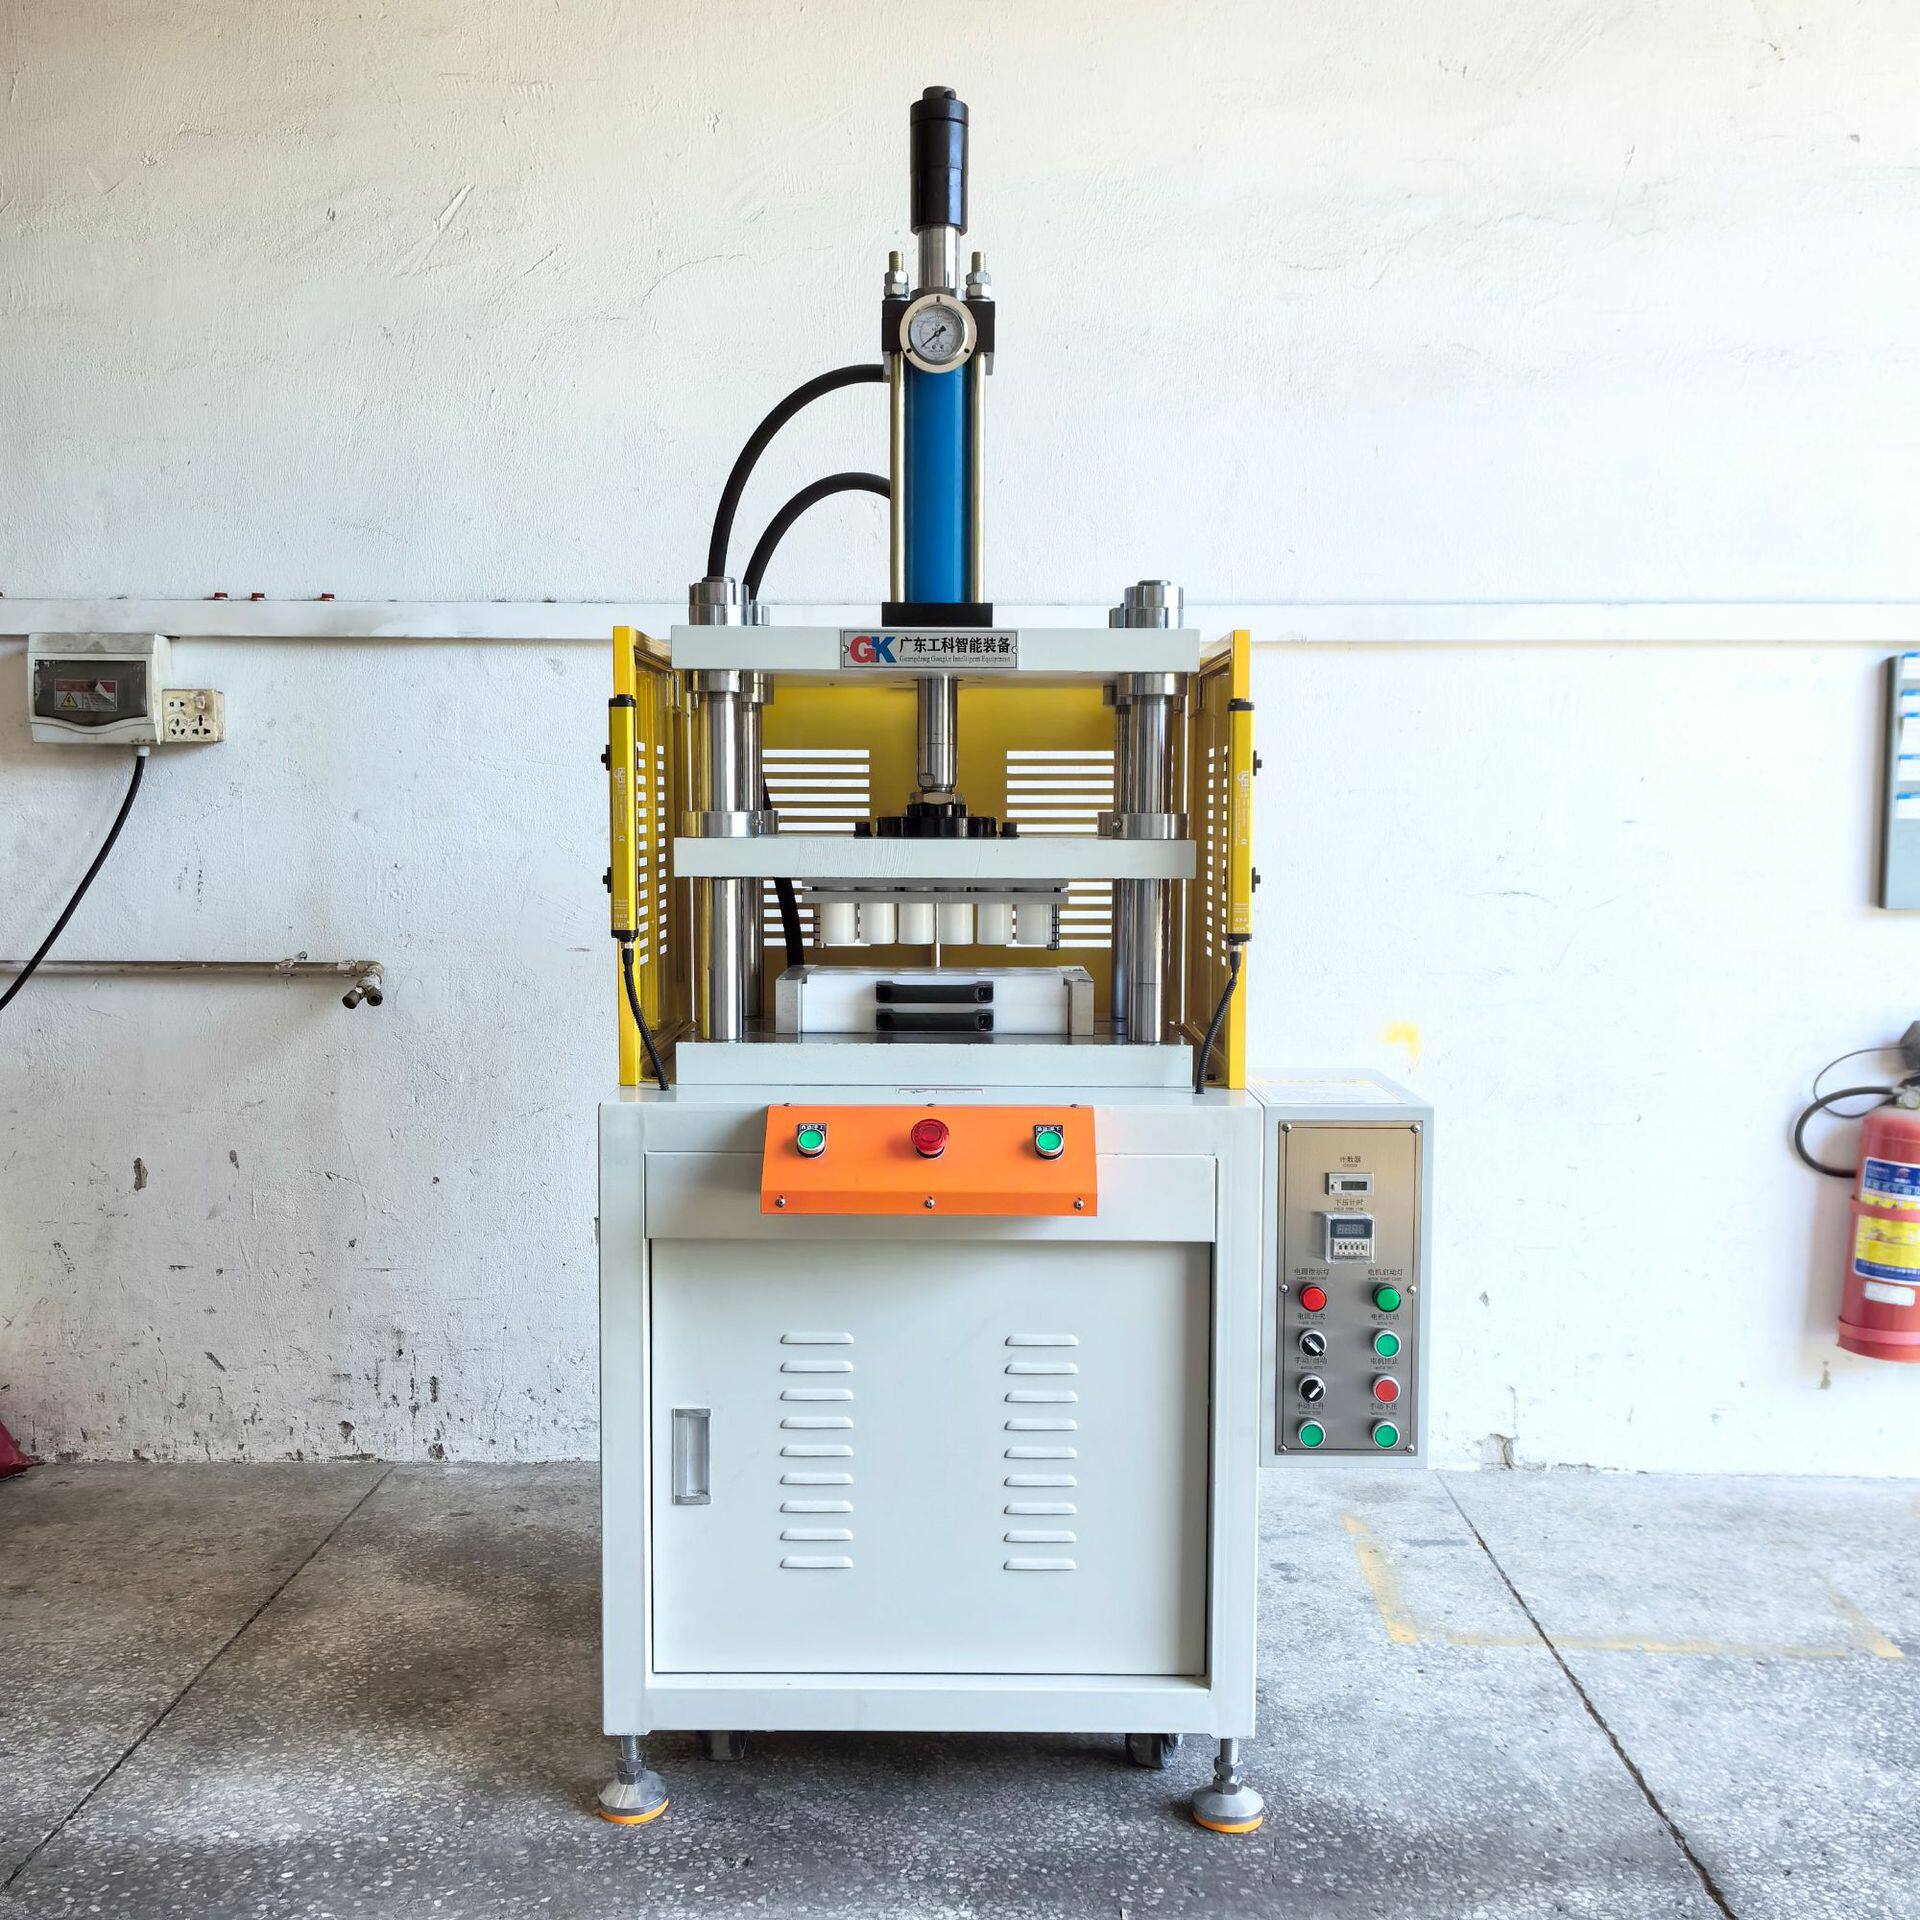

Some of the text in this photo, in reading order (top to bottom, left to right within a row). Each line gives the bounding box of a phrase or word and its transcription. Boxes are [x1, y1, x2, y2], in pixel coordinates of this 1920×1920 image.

[849, 635, 897, 664] GK
[899, 636, 1011, 654] 广东工科智能装备
[952, 655, 981, 664] Intelligent
[981, 655, 1011, 664] Equipment
